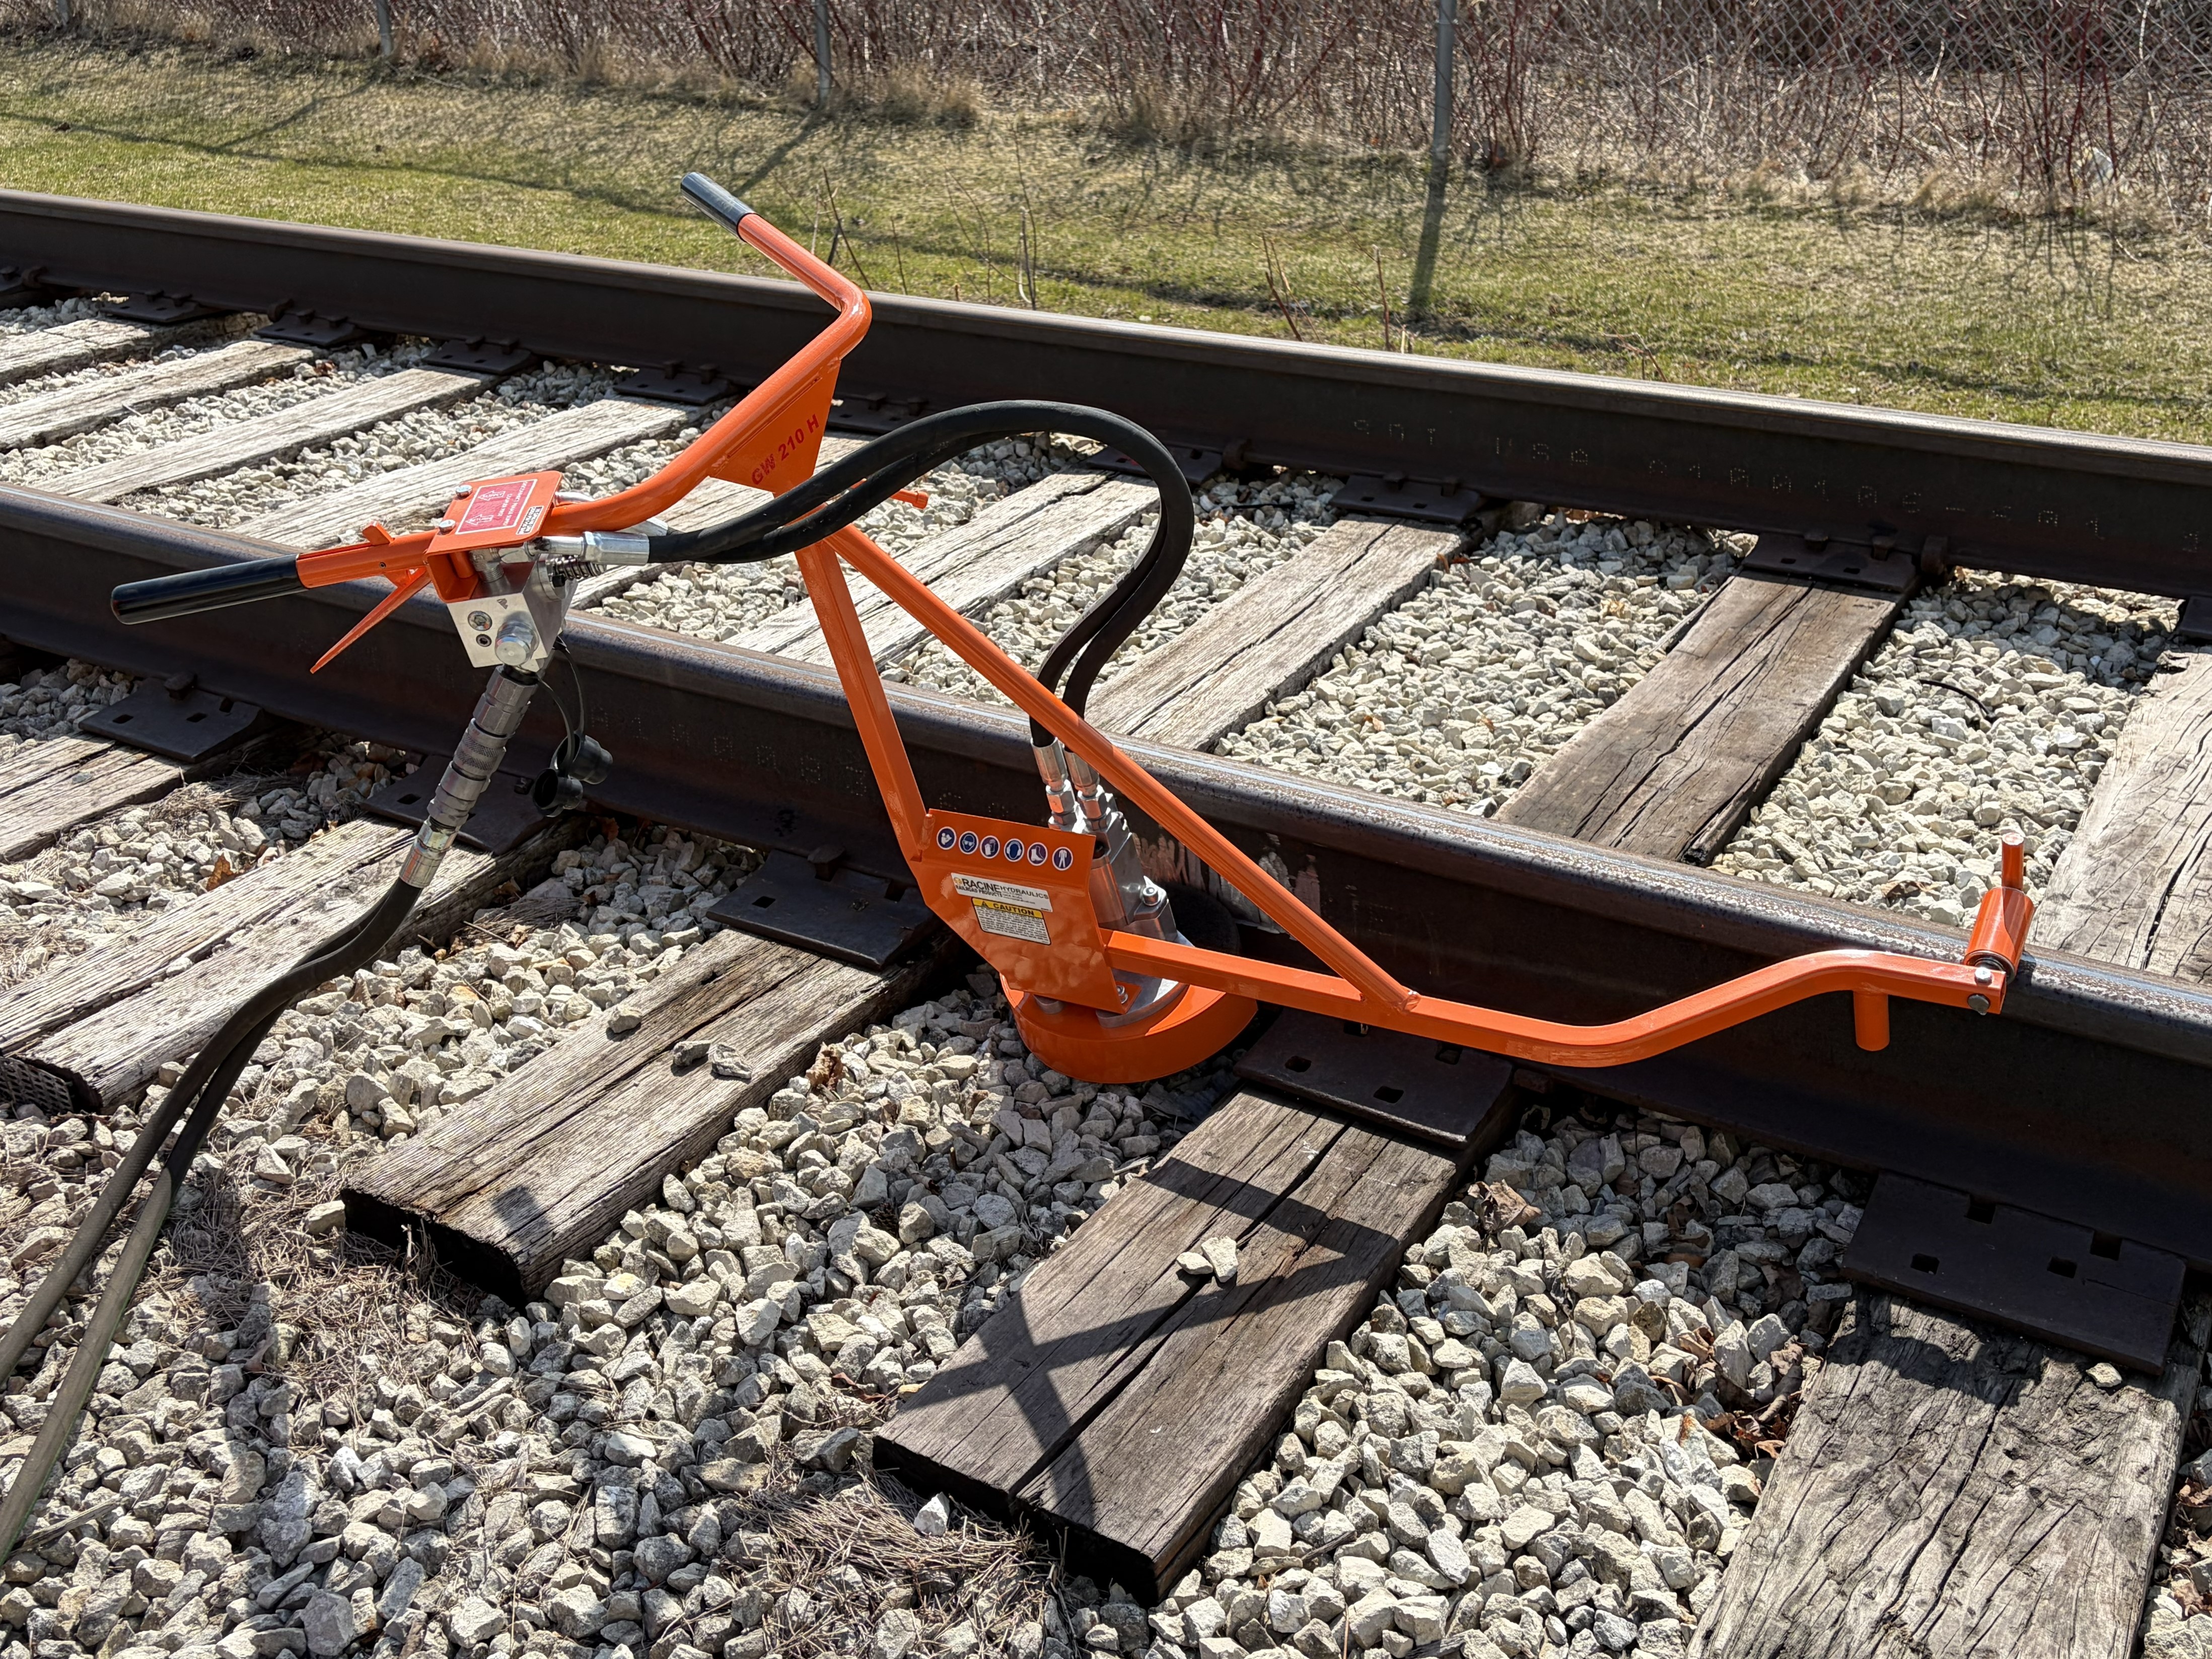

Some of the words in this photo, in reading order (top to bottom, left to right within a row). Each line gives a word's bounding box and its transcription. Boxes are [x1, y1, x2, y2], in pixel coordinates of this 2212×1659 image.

[751, 454, 775, 485] GW
[778, 428, 804, 461] 210
[807, 413, 820, 434] H
[961, 878, 1002, 894] RACINE
[1000, 885, 1049, 900] HYDRAULICS
[992, 903, 1035, 916] CAUTION
